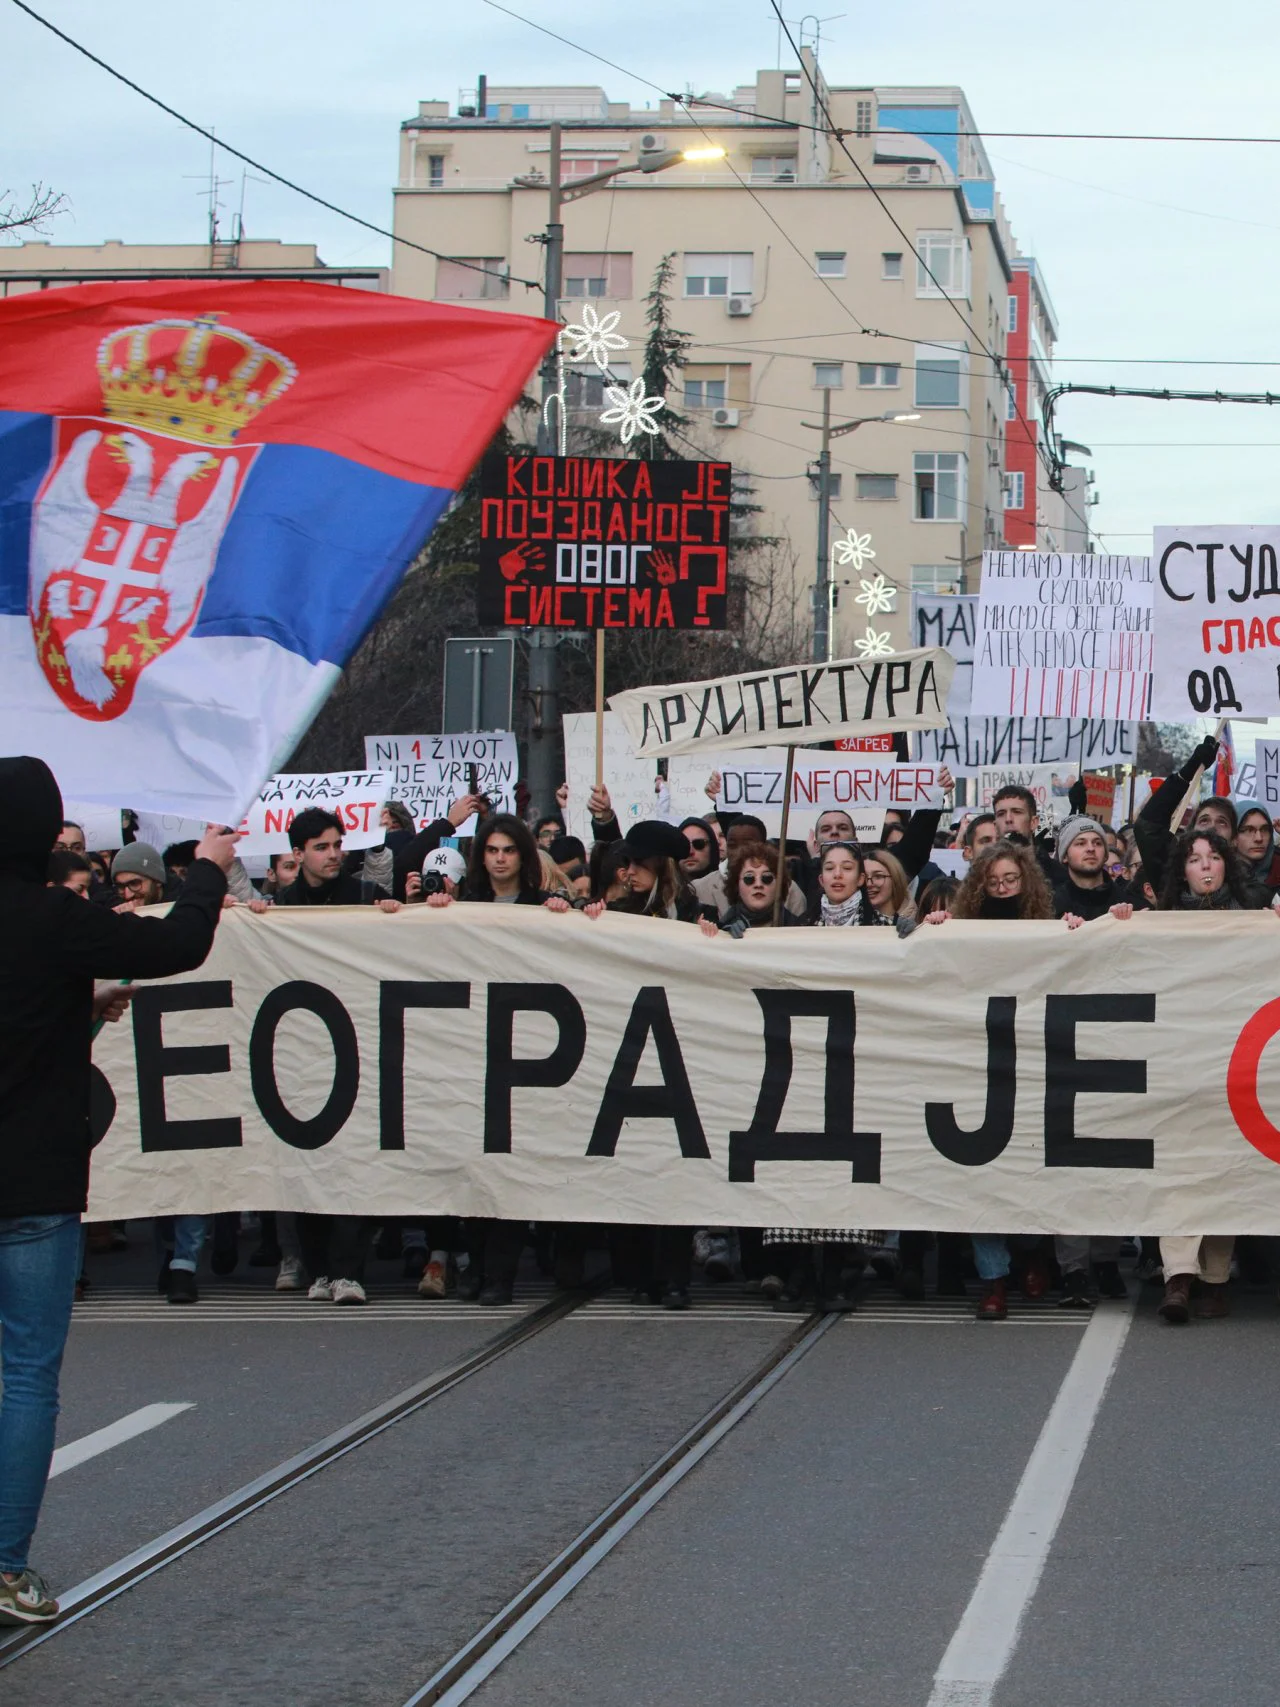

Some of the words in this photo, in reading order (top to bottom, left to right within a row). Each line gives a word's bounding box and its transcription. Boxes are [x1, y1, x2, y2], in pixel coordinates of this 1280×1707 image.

[507, 456, 653, 499] КОЛИКА
[682, 462, 729, 502] ЈЕ
[481, 498, 728, 542] ПОУЗДАНОСТ
[556, 544, 652, 584] ОВОГ
[1071, 553, 1093, 579] МИ
[1099, 555, 1133, 580] ШТА
[504, 585, 675, 628] СИСТЕМА
[641, 661, 942, 748] АРХИТЕКТУРА
[1187, 665, 1242, 713] ОД
[376, 742, 399, 761] NI
[411, 740, 421, 761] 1
[431, 737, 503, 760] ŽIVOT
[840, 737, 889, 751] ЗАГРЕБ
[296, 787, 345, 800] NAS
[982, 771, 1036, 788] ПРАВДУ
[91, 979, 881, 1183] ЕОГРАД
[924, 994, 1156, 1169] ЈЕ
